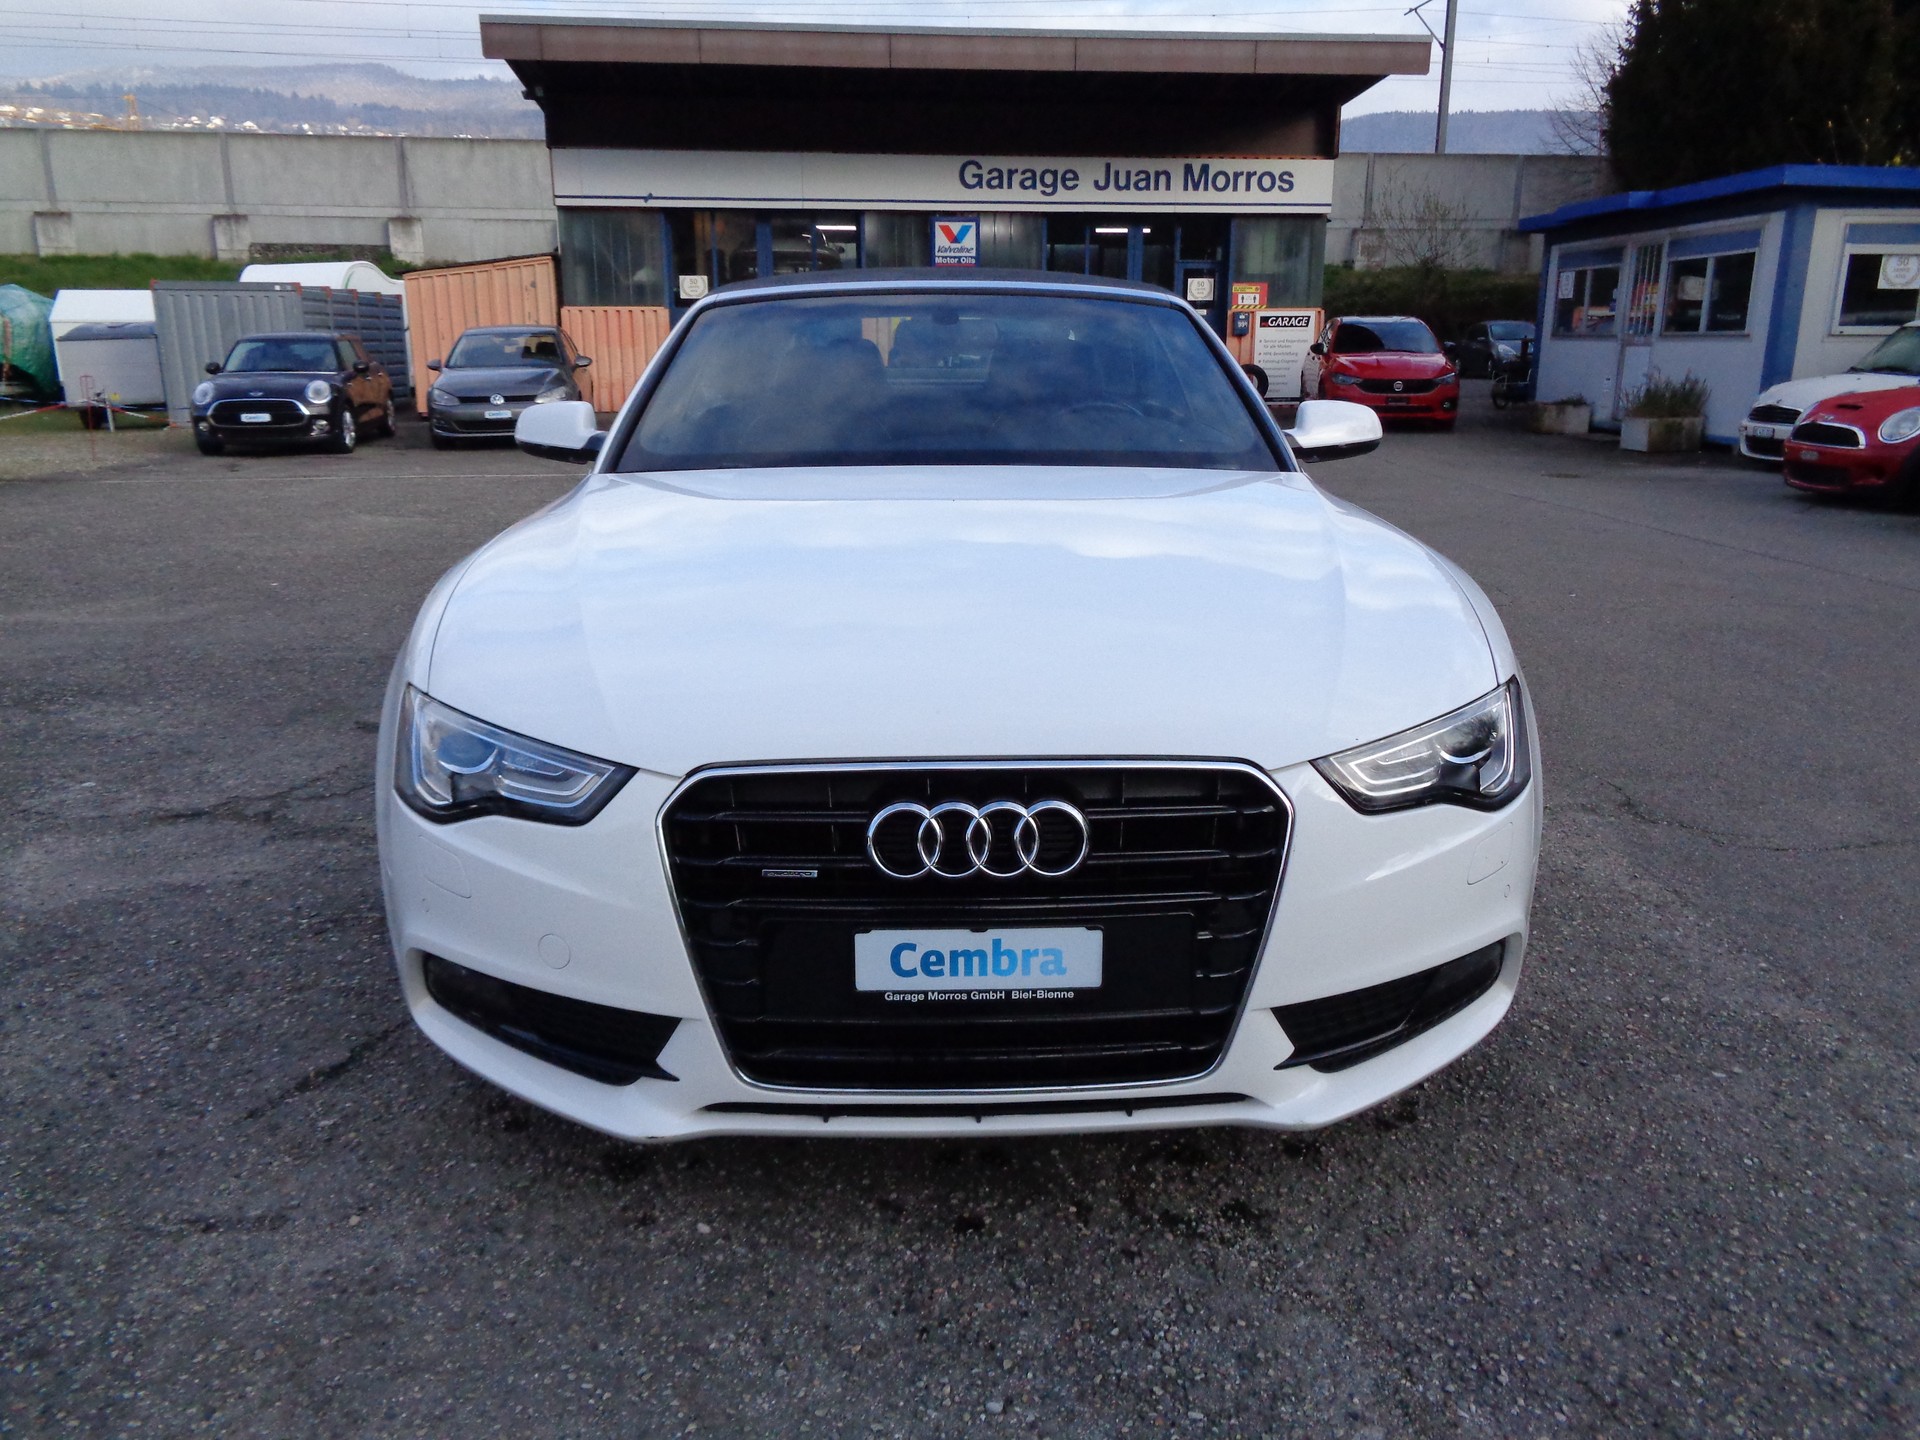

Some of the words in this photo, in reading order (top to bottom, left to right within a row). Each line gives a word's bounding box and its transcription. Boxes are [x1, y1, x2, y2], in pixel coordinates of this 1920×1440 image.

[958, 159, 1080, 196] Garage
[1093, 162, 1172, 191] Juan
[1182, 163, 1295, 192] Morros
[937, 245, 974, 254] Valvoline
[935, 256, 959, 264] Motor
[960, 256, 976, 264] Oils
[1268, 316, 1309, 327] GARAGE
[890, 938, 1068, 978] Cembra
[884, 991, 925, 1002] Garage
[927, 991, 968, 1001] Morros
[970, 990, 1006, 1000] GmbH
[1011, 989, 1075, 999] Biel-Bienne
